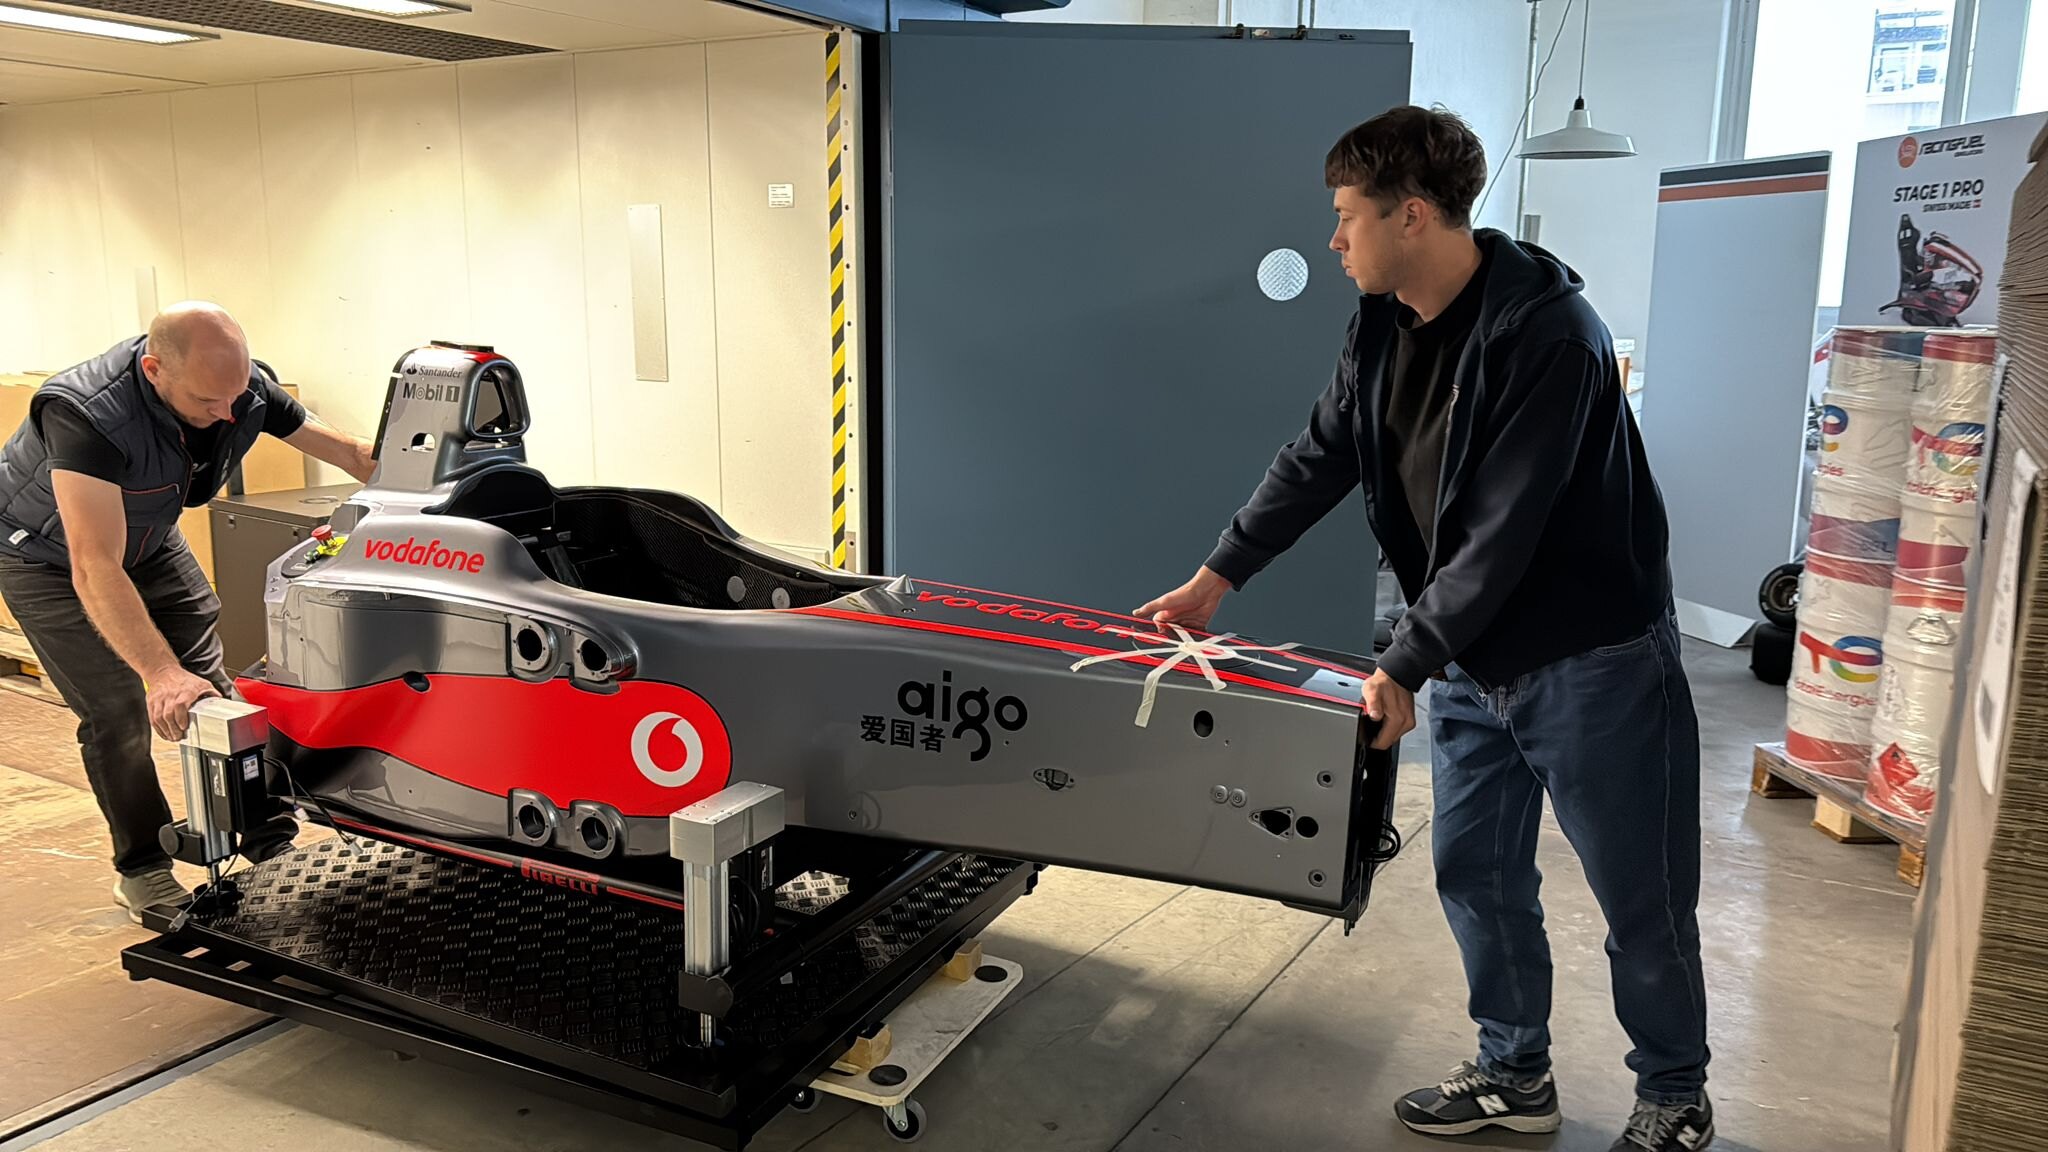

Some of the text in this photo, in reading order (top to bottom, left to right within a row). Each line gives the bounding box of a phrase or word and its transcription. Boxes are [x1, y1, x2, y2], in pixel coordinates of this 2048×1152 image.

[1893, 179, 1984, 202] STAGE 1 PRO
[418, 365, 463, 378] Santander
[402, 382, 443, 401] Mobil
[365, 537, 485, 573] vodafone
[898, 670, 1028, 761] aigo
[860, 714, 946, 753] 爱国者
[521, 858, 600, 895] PIRELLI
[1476, 1094, 1509, 1115] N
